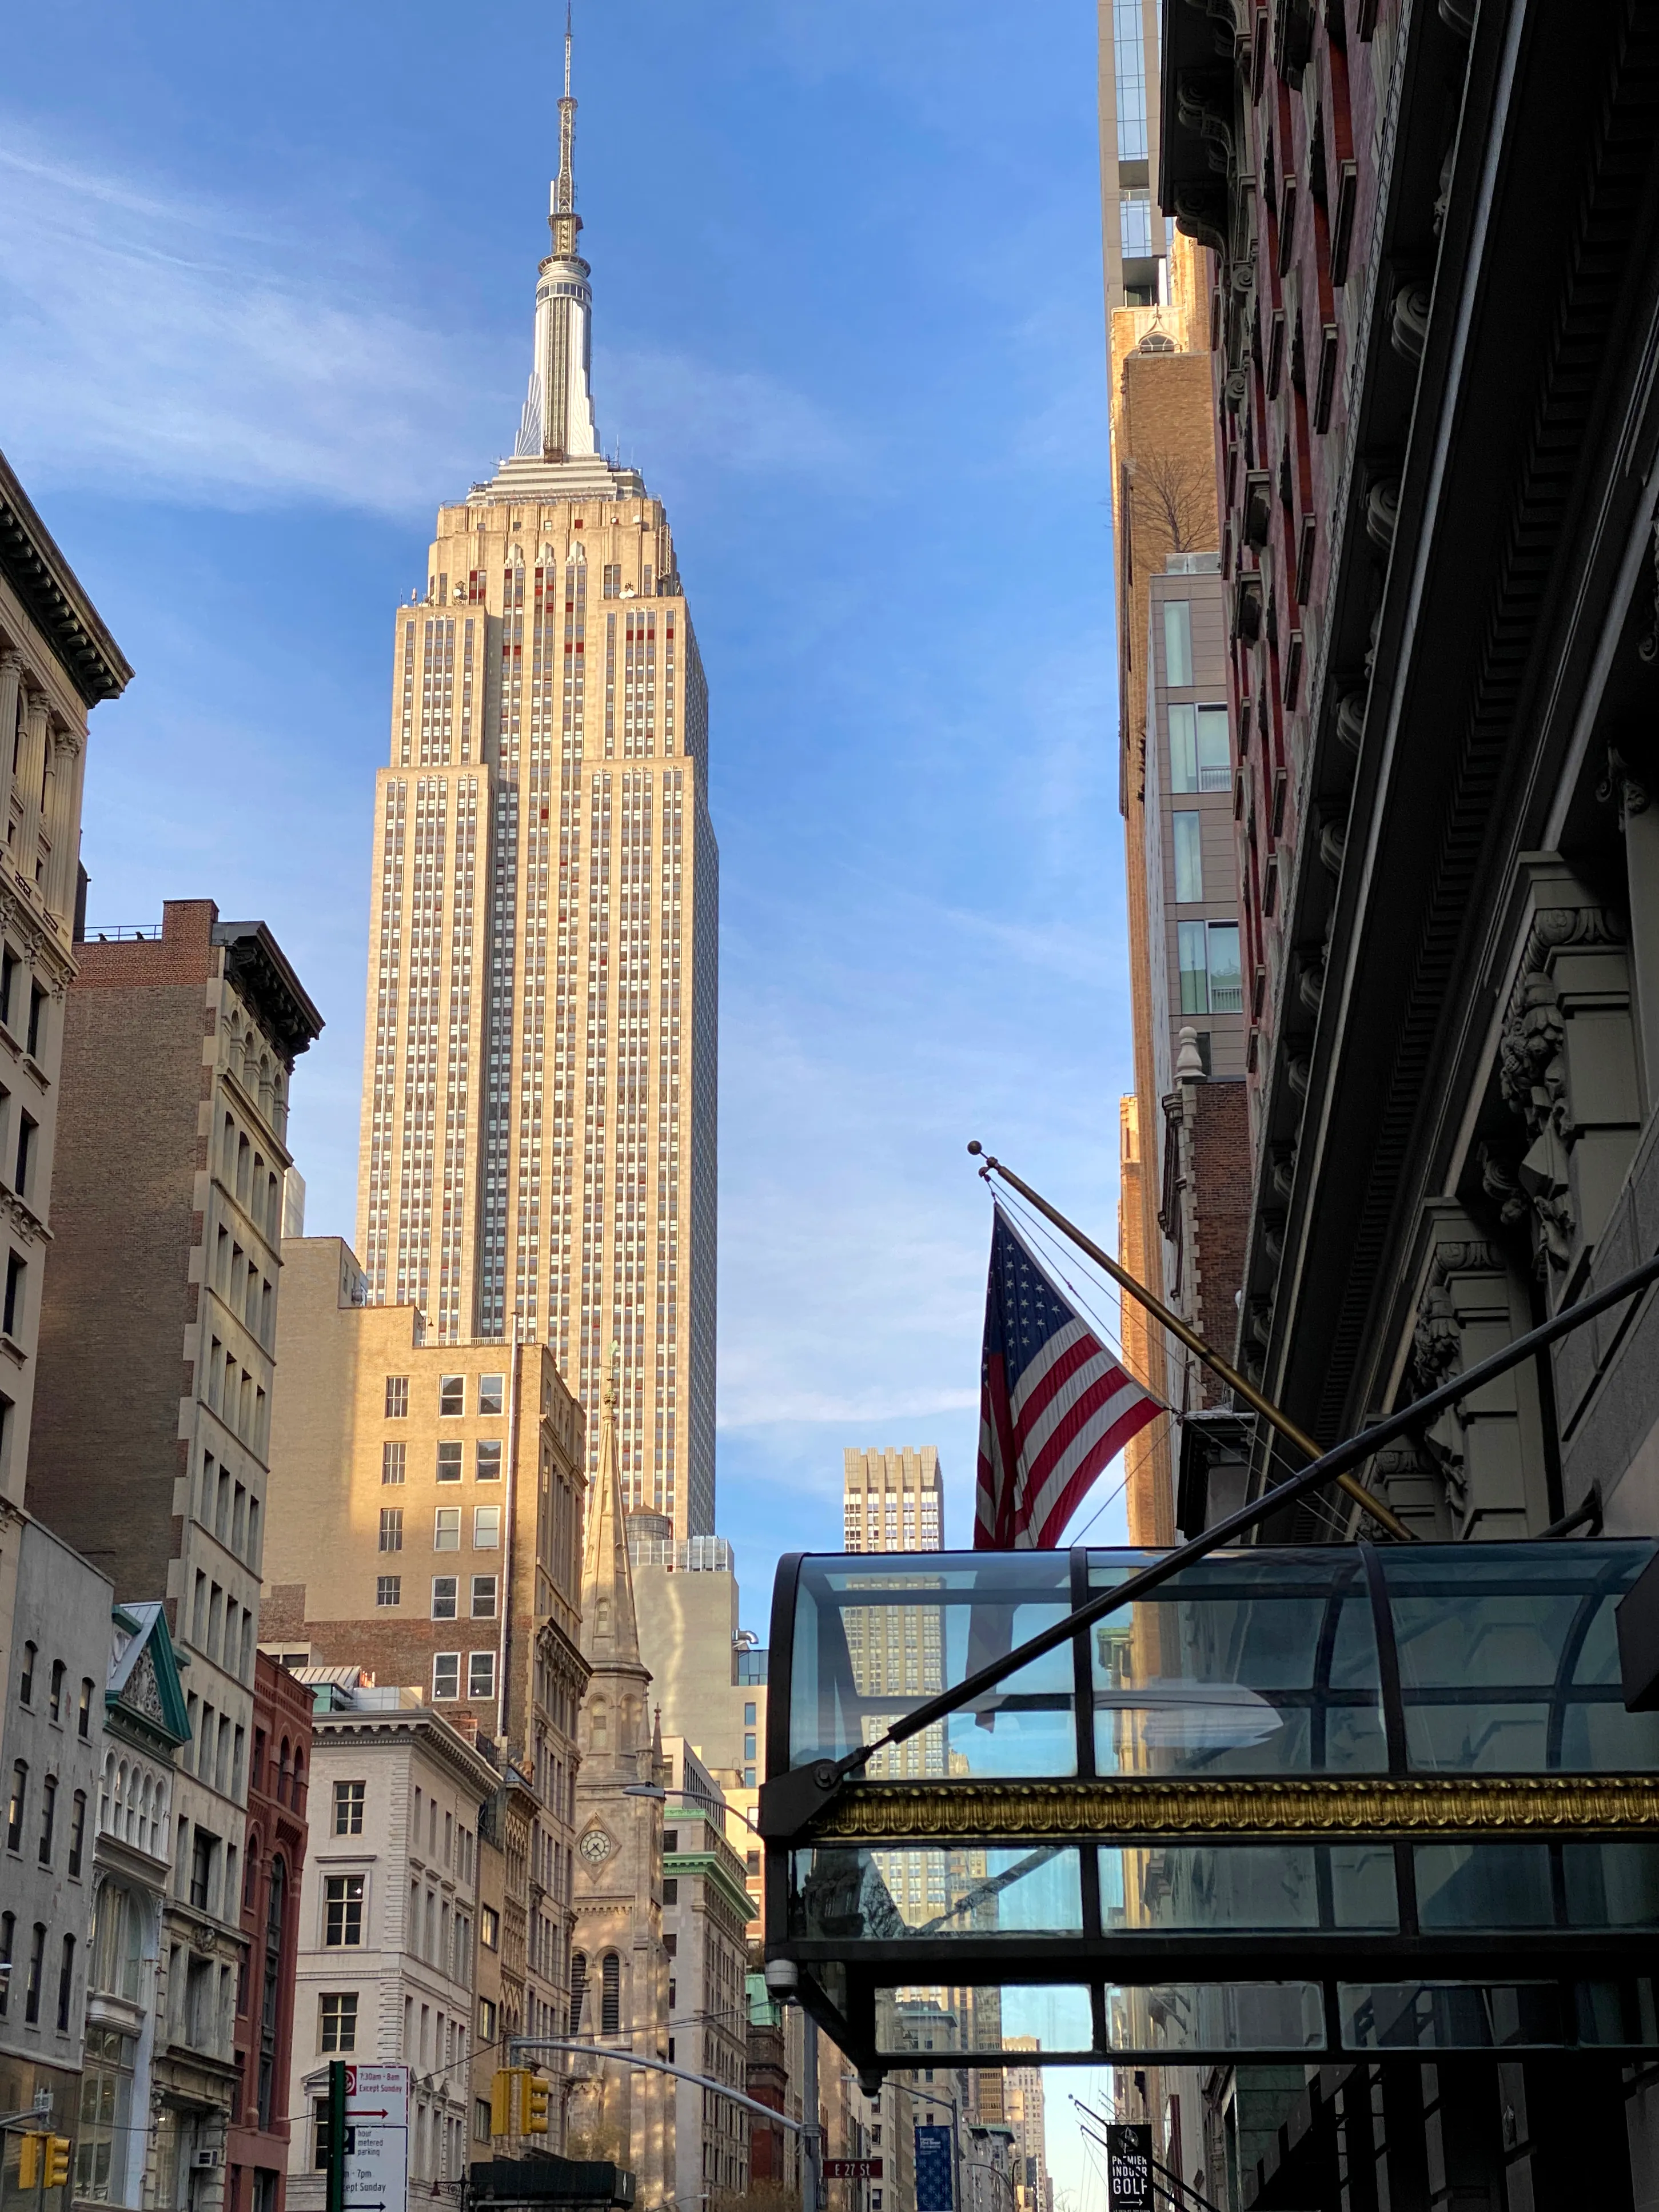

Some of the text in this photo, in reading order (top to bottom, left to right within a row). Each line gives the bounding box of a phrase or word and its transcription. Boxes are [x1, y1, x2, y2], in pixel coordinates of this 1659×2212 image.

[360, 2071, 381, 2081] 7:30am
[386, 2072, 400, 2081] 8am
[359, 2085, 402, 2094] Except Sunday
[357, 2148, 380, 2157] parking
[357, 2169, 372, 2179] 7pm
[835, 2163, 870, 2176] E 27 St
[360, 2182, 386, 2193] Sunday
[1113, 2178, 1147, 2195] GOLF
